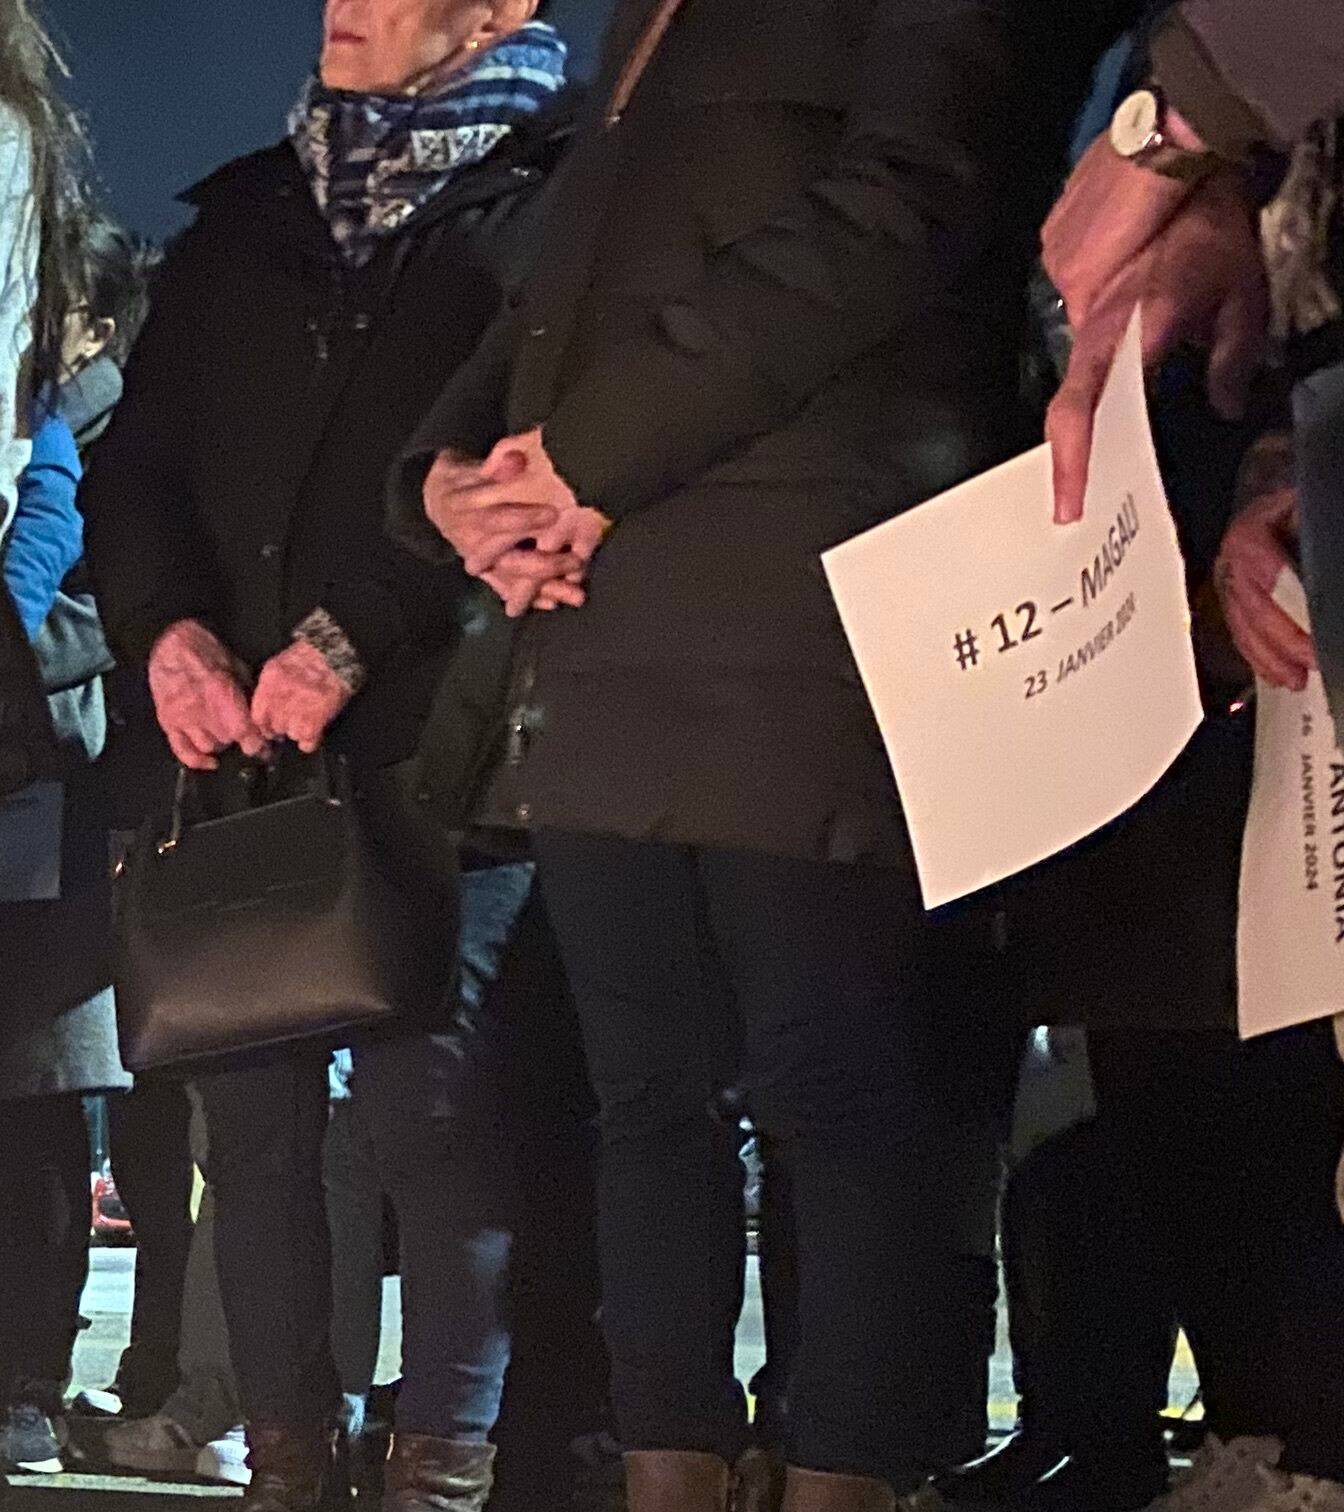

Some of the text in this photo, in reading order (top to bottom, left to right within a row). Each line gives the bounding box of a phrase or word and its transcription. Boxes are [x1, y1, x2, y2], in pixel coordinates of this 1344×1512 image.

[953, 629, 981, 671] #
[990, 600, 1044, 654] 12
[1081, 491, 1140, 608] MAGALI
[1024, 669, 1048, 700] 23
[1301, 754, 1317, 837] JANVIER
[1305, 843, 1319, 891] 2024
